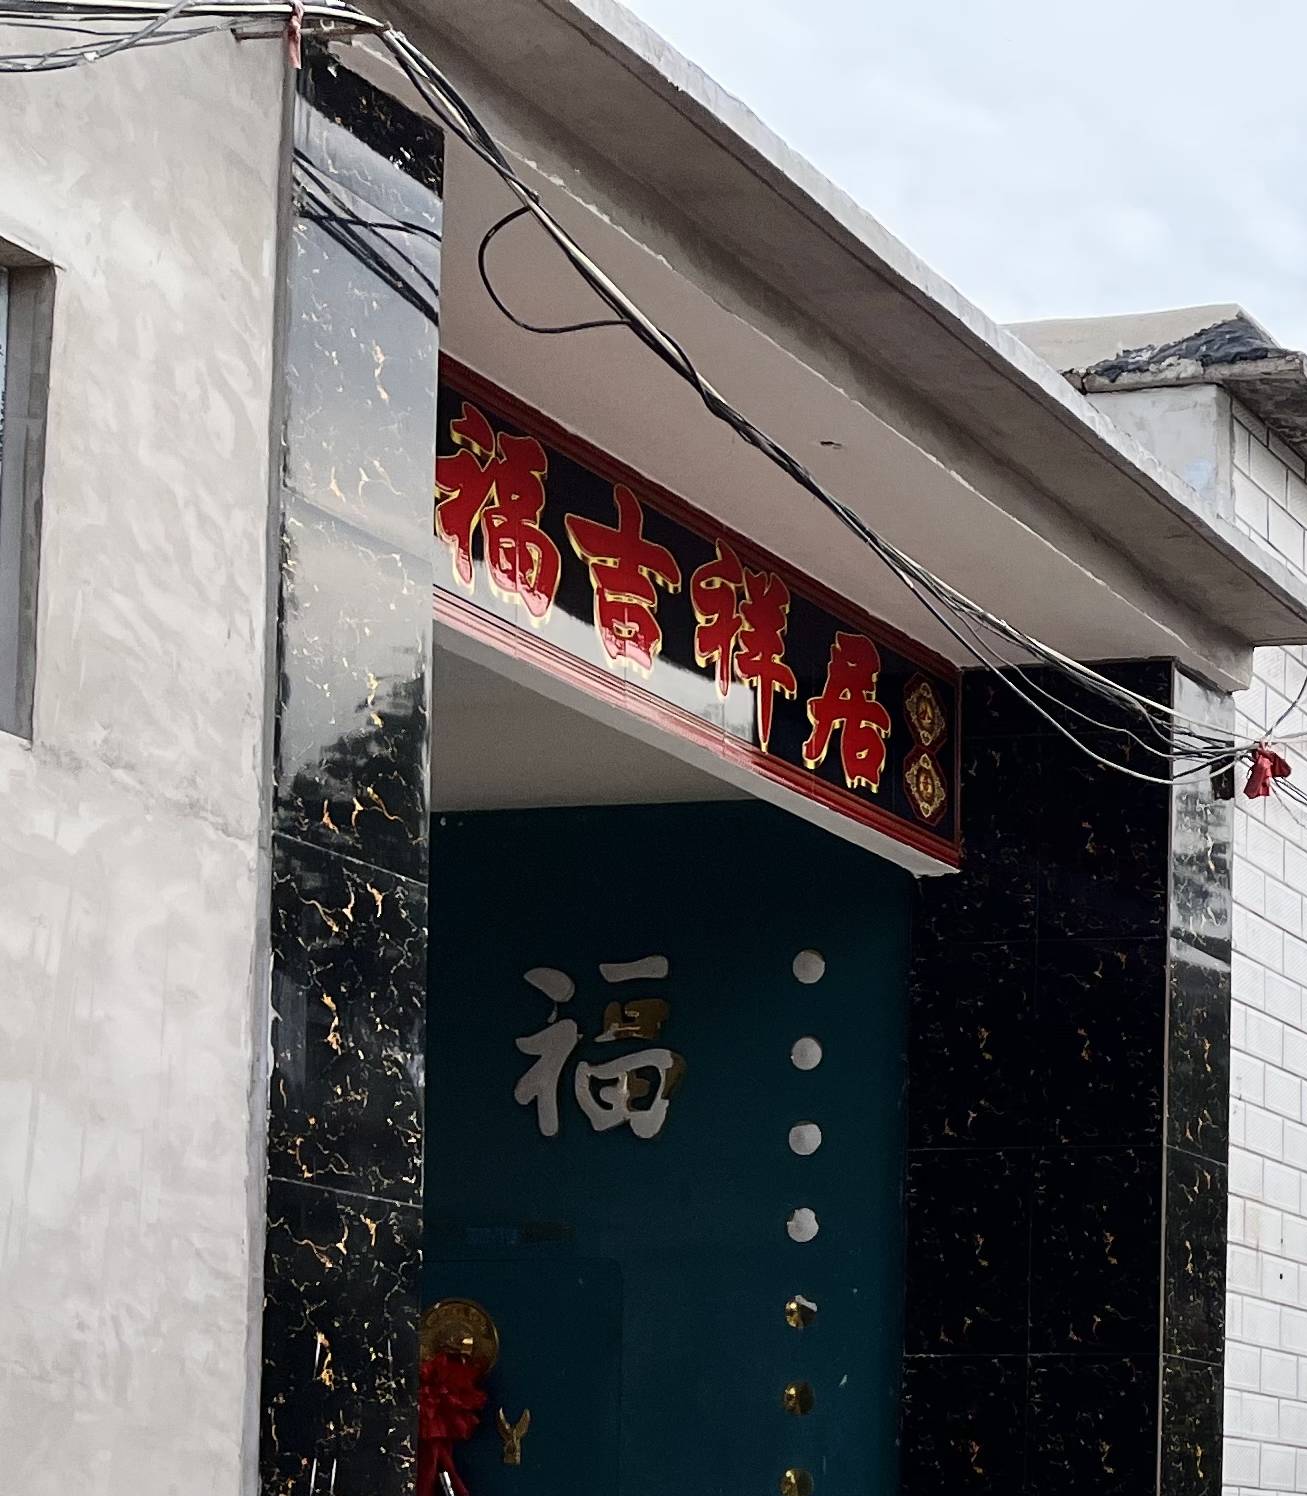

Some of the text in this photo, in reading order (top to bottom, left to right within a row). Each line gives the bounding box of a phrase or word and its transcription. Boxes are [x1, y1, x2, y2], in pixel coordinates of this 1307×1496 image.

[435, 402, 891, 793] 福吉祥居
[514, 955, 687, 1139] 福
